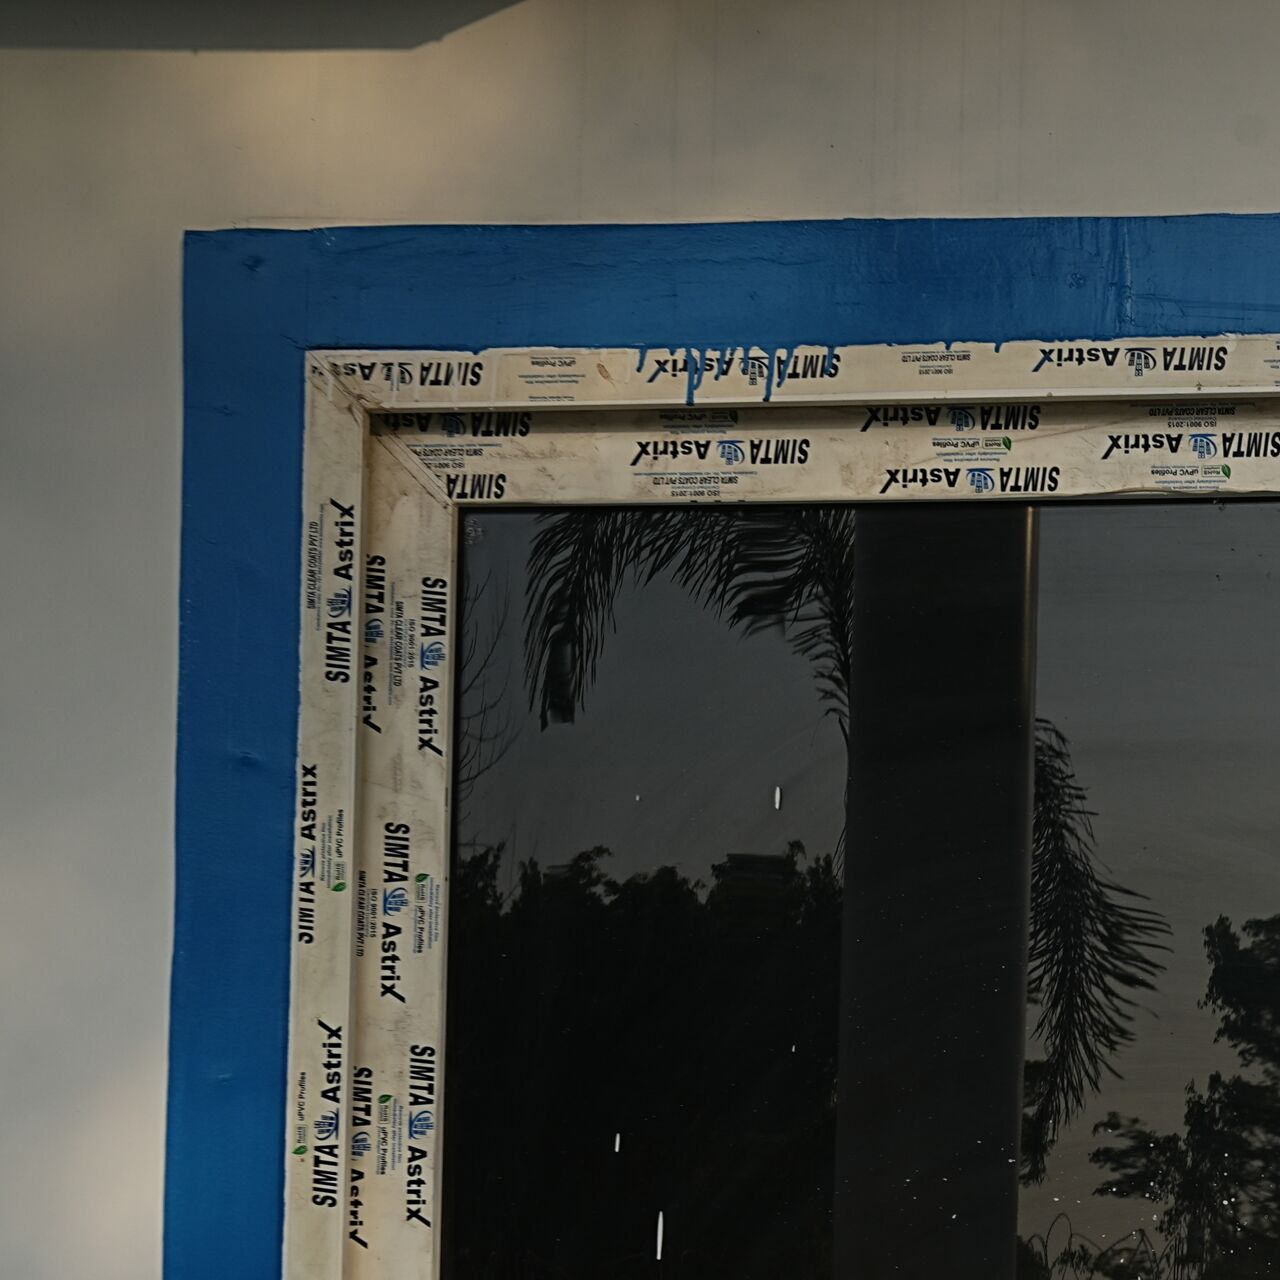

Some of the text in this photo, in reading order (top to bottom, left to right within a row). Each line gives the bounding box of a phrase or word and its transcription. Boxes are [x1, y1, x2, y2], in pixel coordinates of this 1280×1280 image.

[1163, 347, 1227, 370] SIMTA
[470, 411, 531, 437] SIMTA
[980, 404, 1042, 433] SIMTA
[750, 439, 809, 464] SIMTA
[446, 474, 506, 499] SIMTA
[1000, 467, 1060, 492] SIMTA
[421, 577, 447, 637] SIMTA
[325, 621, 351, 683] SIMTA
[384, 822, 410, 882] SIMTA
[409, 1045, 435, 1105] SIMTA
[312, 1145, 338, 1207] SIMTA
